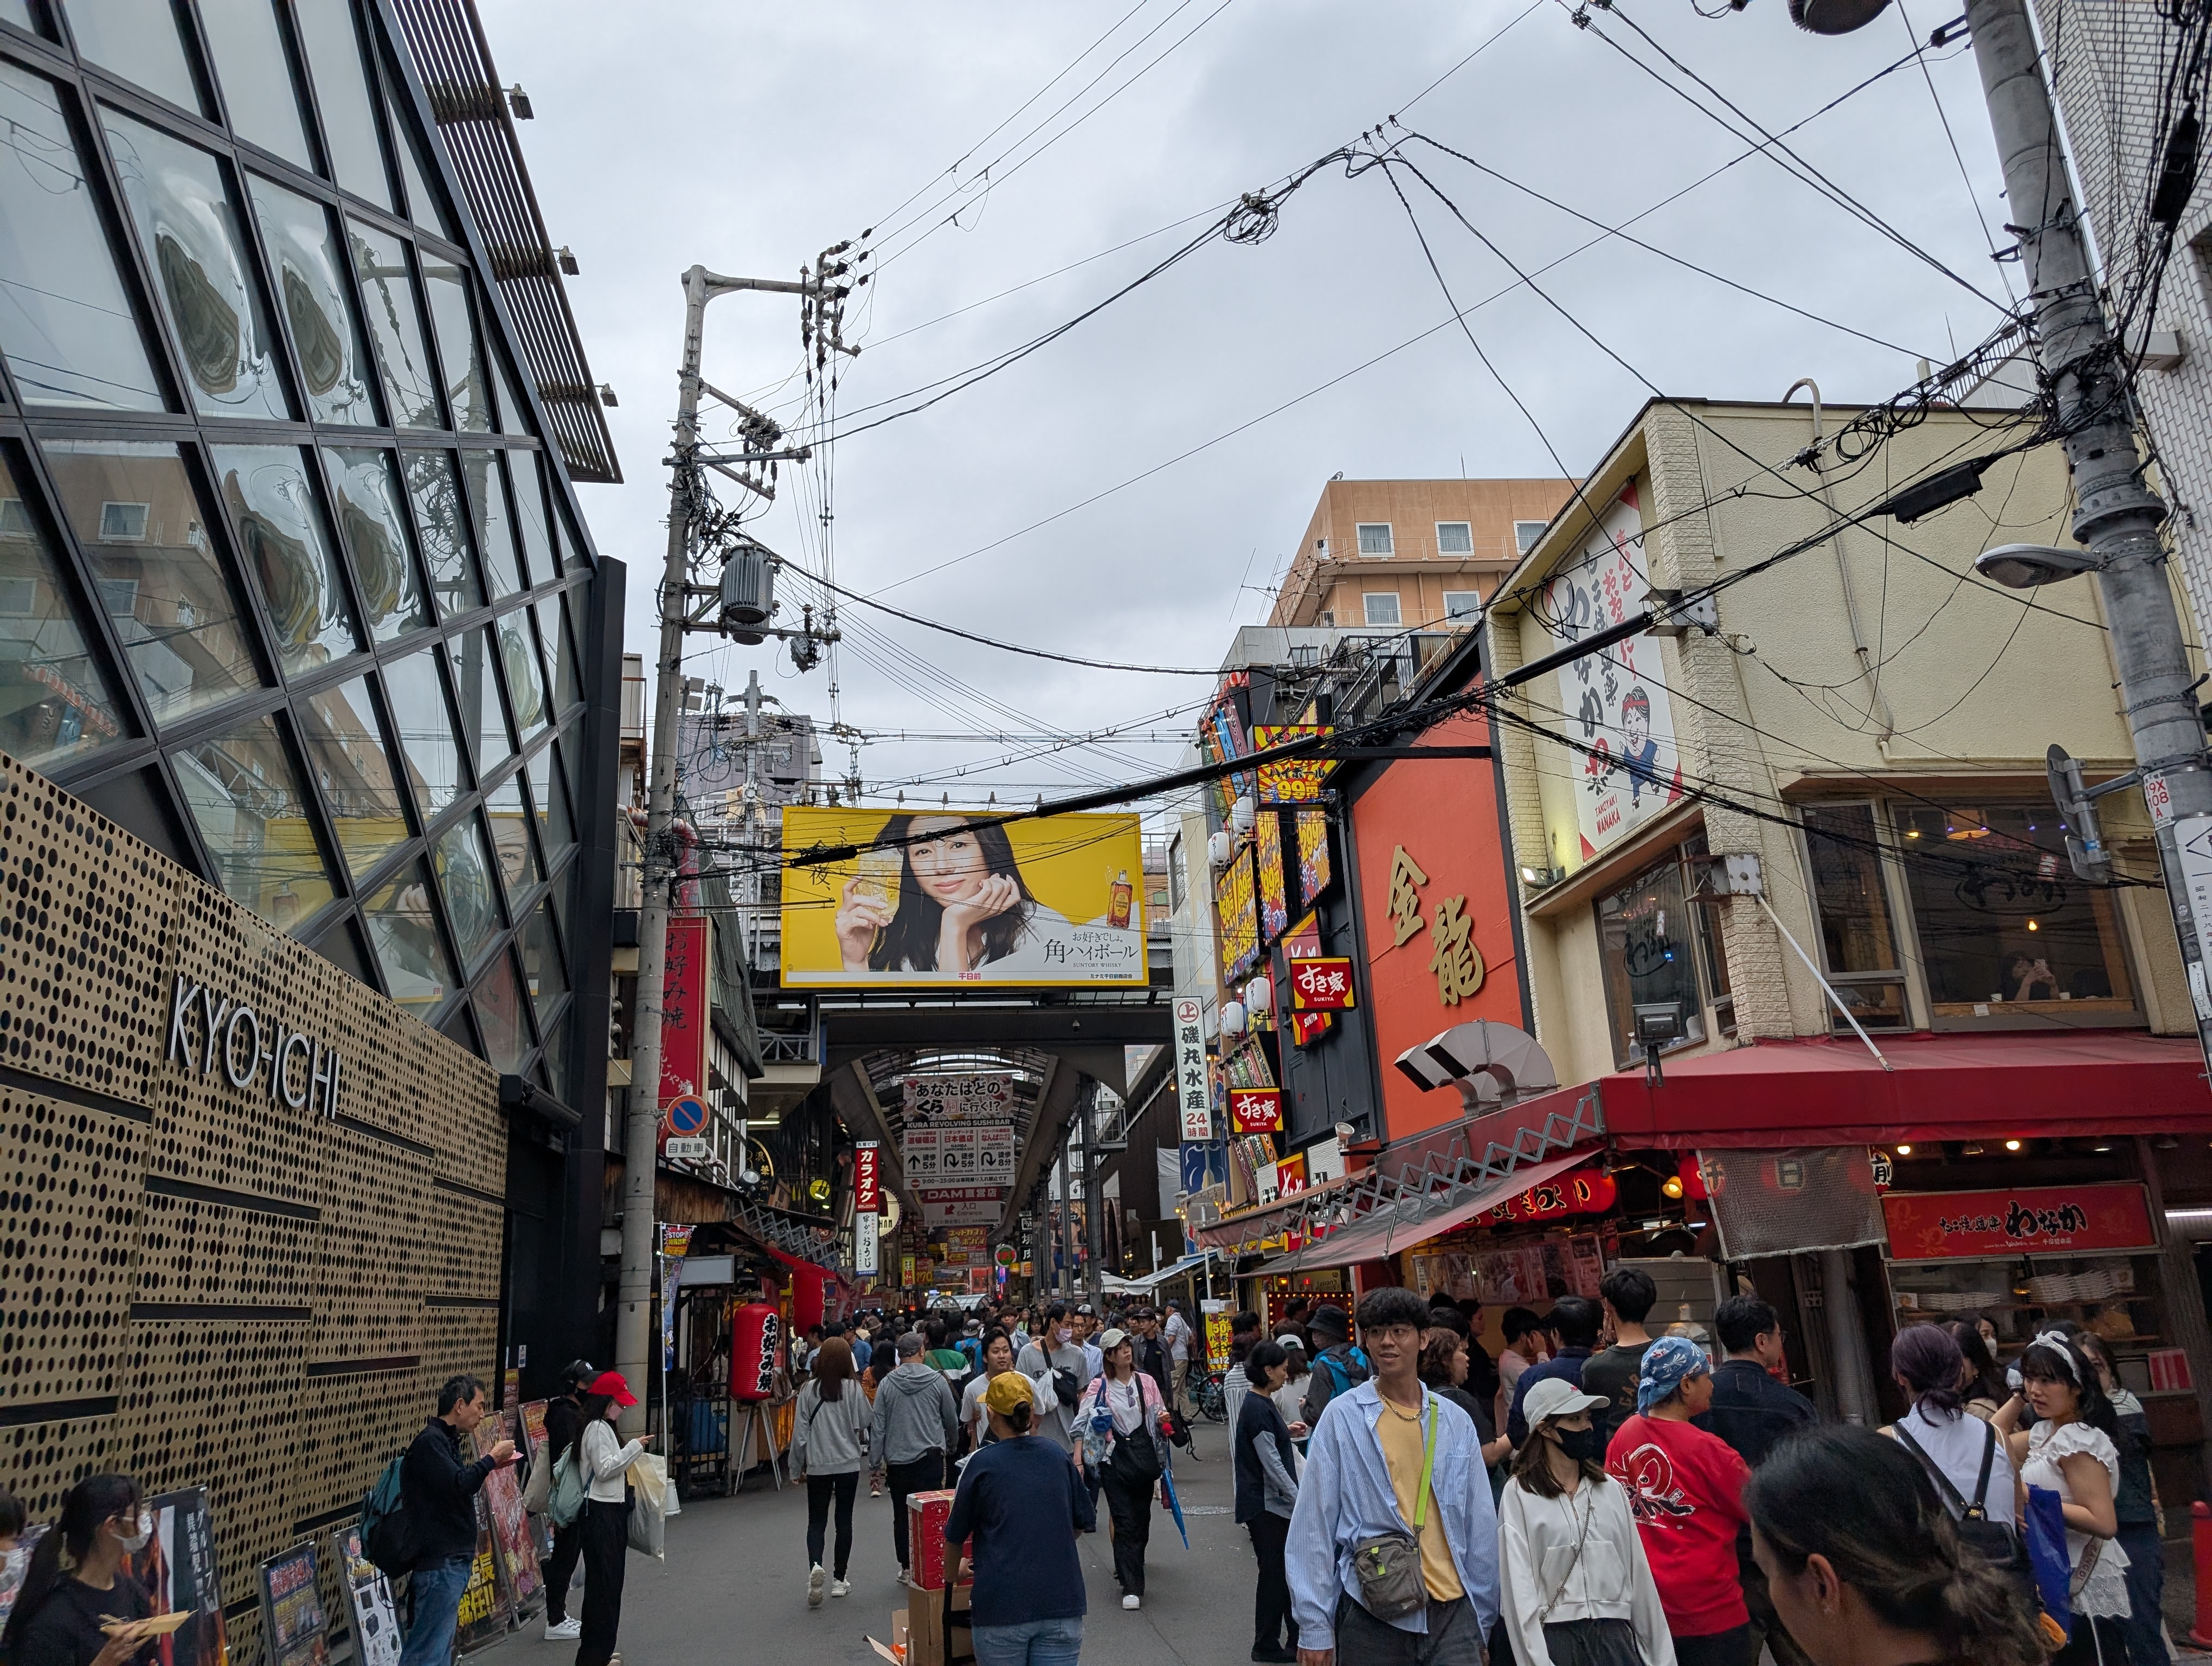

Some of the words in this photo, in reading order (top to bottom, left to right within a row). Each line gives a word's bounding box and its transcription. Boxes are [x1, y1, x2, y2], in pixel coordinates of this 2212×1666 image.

[1269, 767, 1326, 779] ハイボール
[1277, 780, 1319, 800] 99円
[1594, 793, 1618, 817] TAKOYAKI
[2148, 792, 2169, 809] 108
[2156, 807, 2163, 819] A
[1596, 808, 1621, 836] WANAKA
[1072, 931, 1123, 943] お好きでしょ。
[1043, 939, 1139, 964] 角ハイボール
[661, 932, 688, 1029] お好み焼
[958, 972, 982, 981] 千日前
[1298, 964, 1346, 996] すき家
[1304, 1013, 1318, 1028] SUKIYA
[169, 975, 340, 1121] KYO-ICHI
[1181, 1026, 1206, 1110] 磯丸水産
[916, 1081, 1001, 1097] あなたはどの
[1237, 1094, 1277, 1122] すき家
[1186, 1112, 1207, 1125] 24
[944, 1135, 974, 1143] 日本橋店
[1187, 1127, 1208, 1137] 時間
[668, 1142, 704, 1154] 自動車
[860, 1150, 874, 1203] カラオケ
[928, 1189, 963, 1200] DAM
[965, 1188, 997, 1198] 直営店
[962, 1202, 976, 1210] 入口
[2004, 1200, 2088, 1239] わなか
[948, 1228, 984, 1236] ネットカフェ
[863, 1236, 872, 1268] おうじ
[1316, 1279, 1338, 1288] Japan's
[1212, 1323, 1233, 1334] 50円
[756, 1313, 778, 1392] お好み焼
